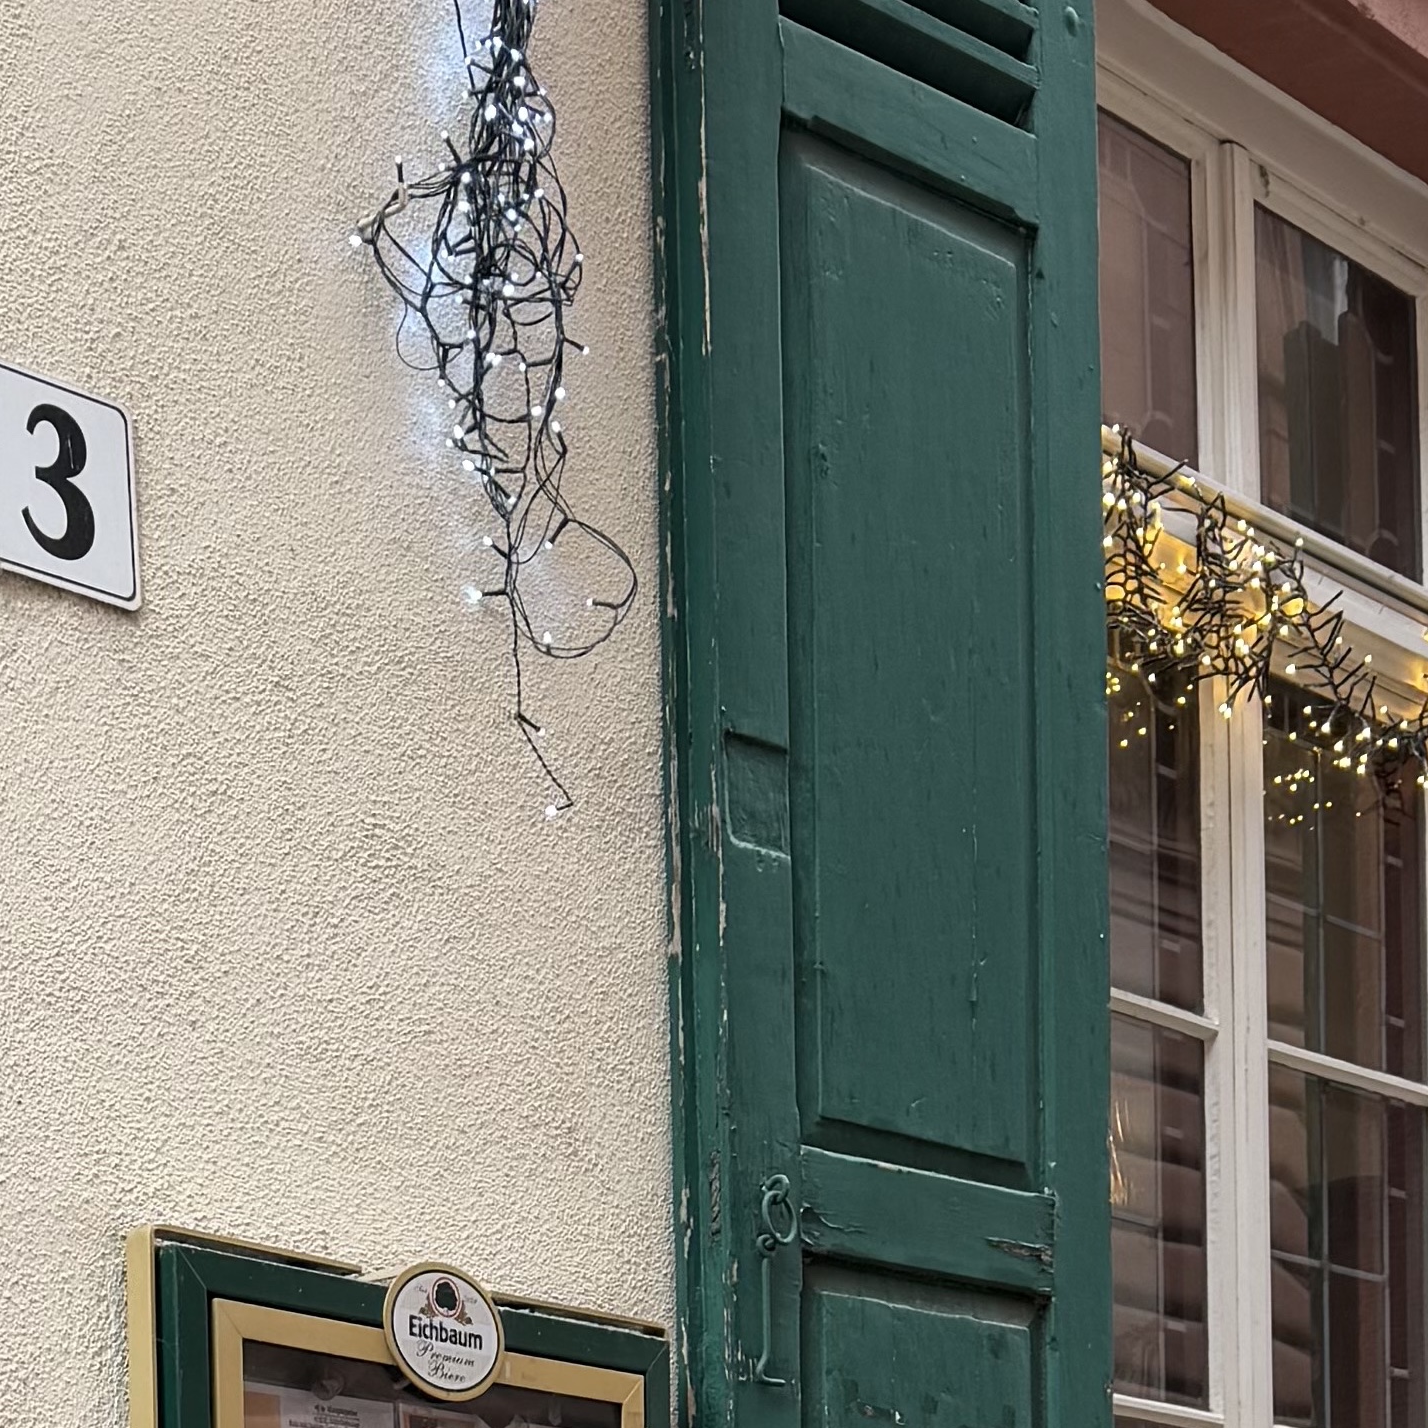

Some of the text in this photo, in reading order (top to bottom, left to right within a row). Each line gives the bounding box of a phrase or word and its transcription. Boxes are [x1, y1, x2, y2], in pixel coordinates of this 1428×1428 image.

[21, 403, 96, 561] 3
[408, 1313, 483, 1352] Eichbaum
[416, 1340, 476, 1368] Premium
